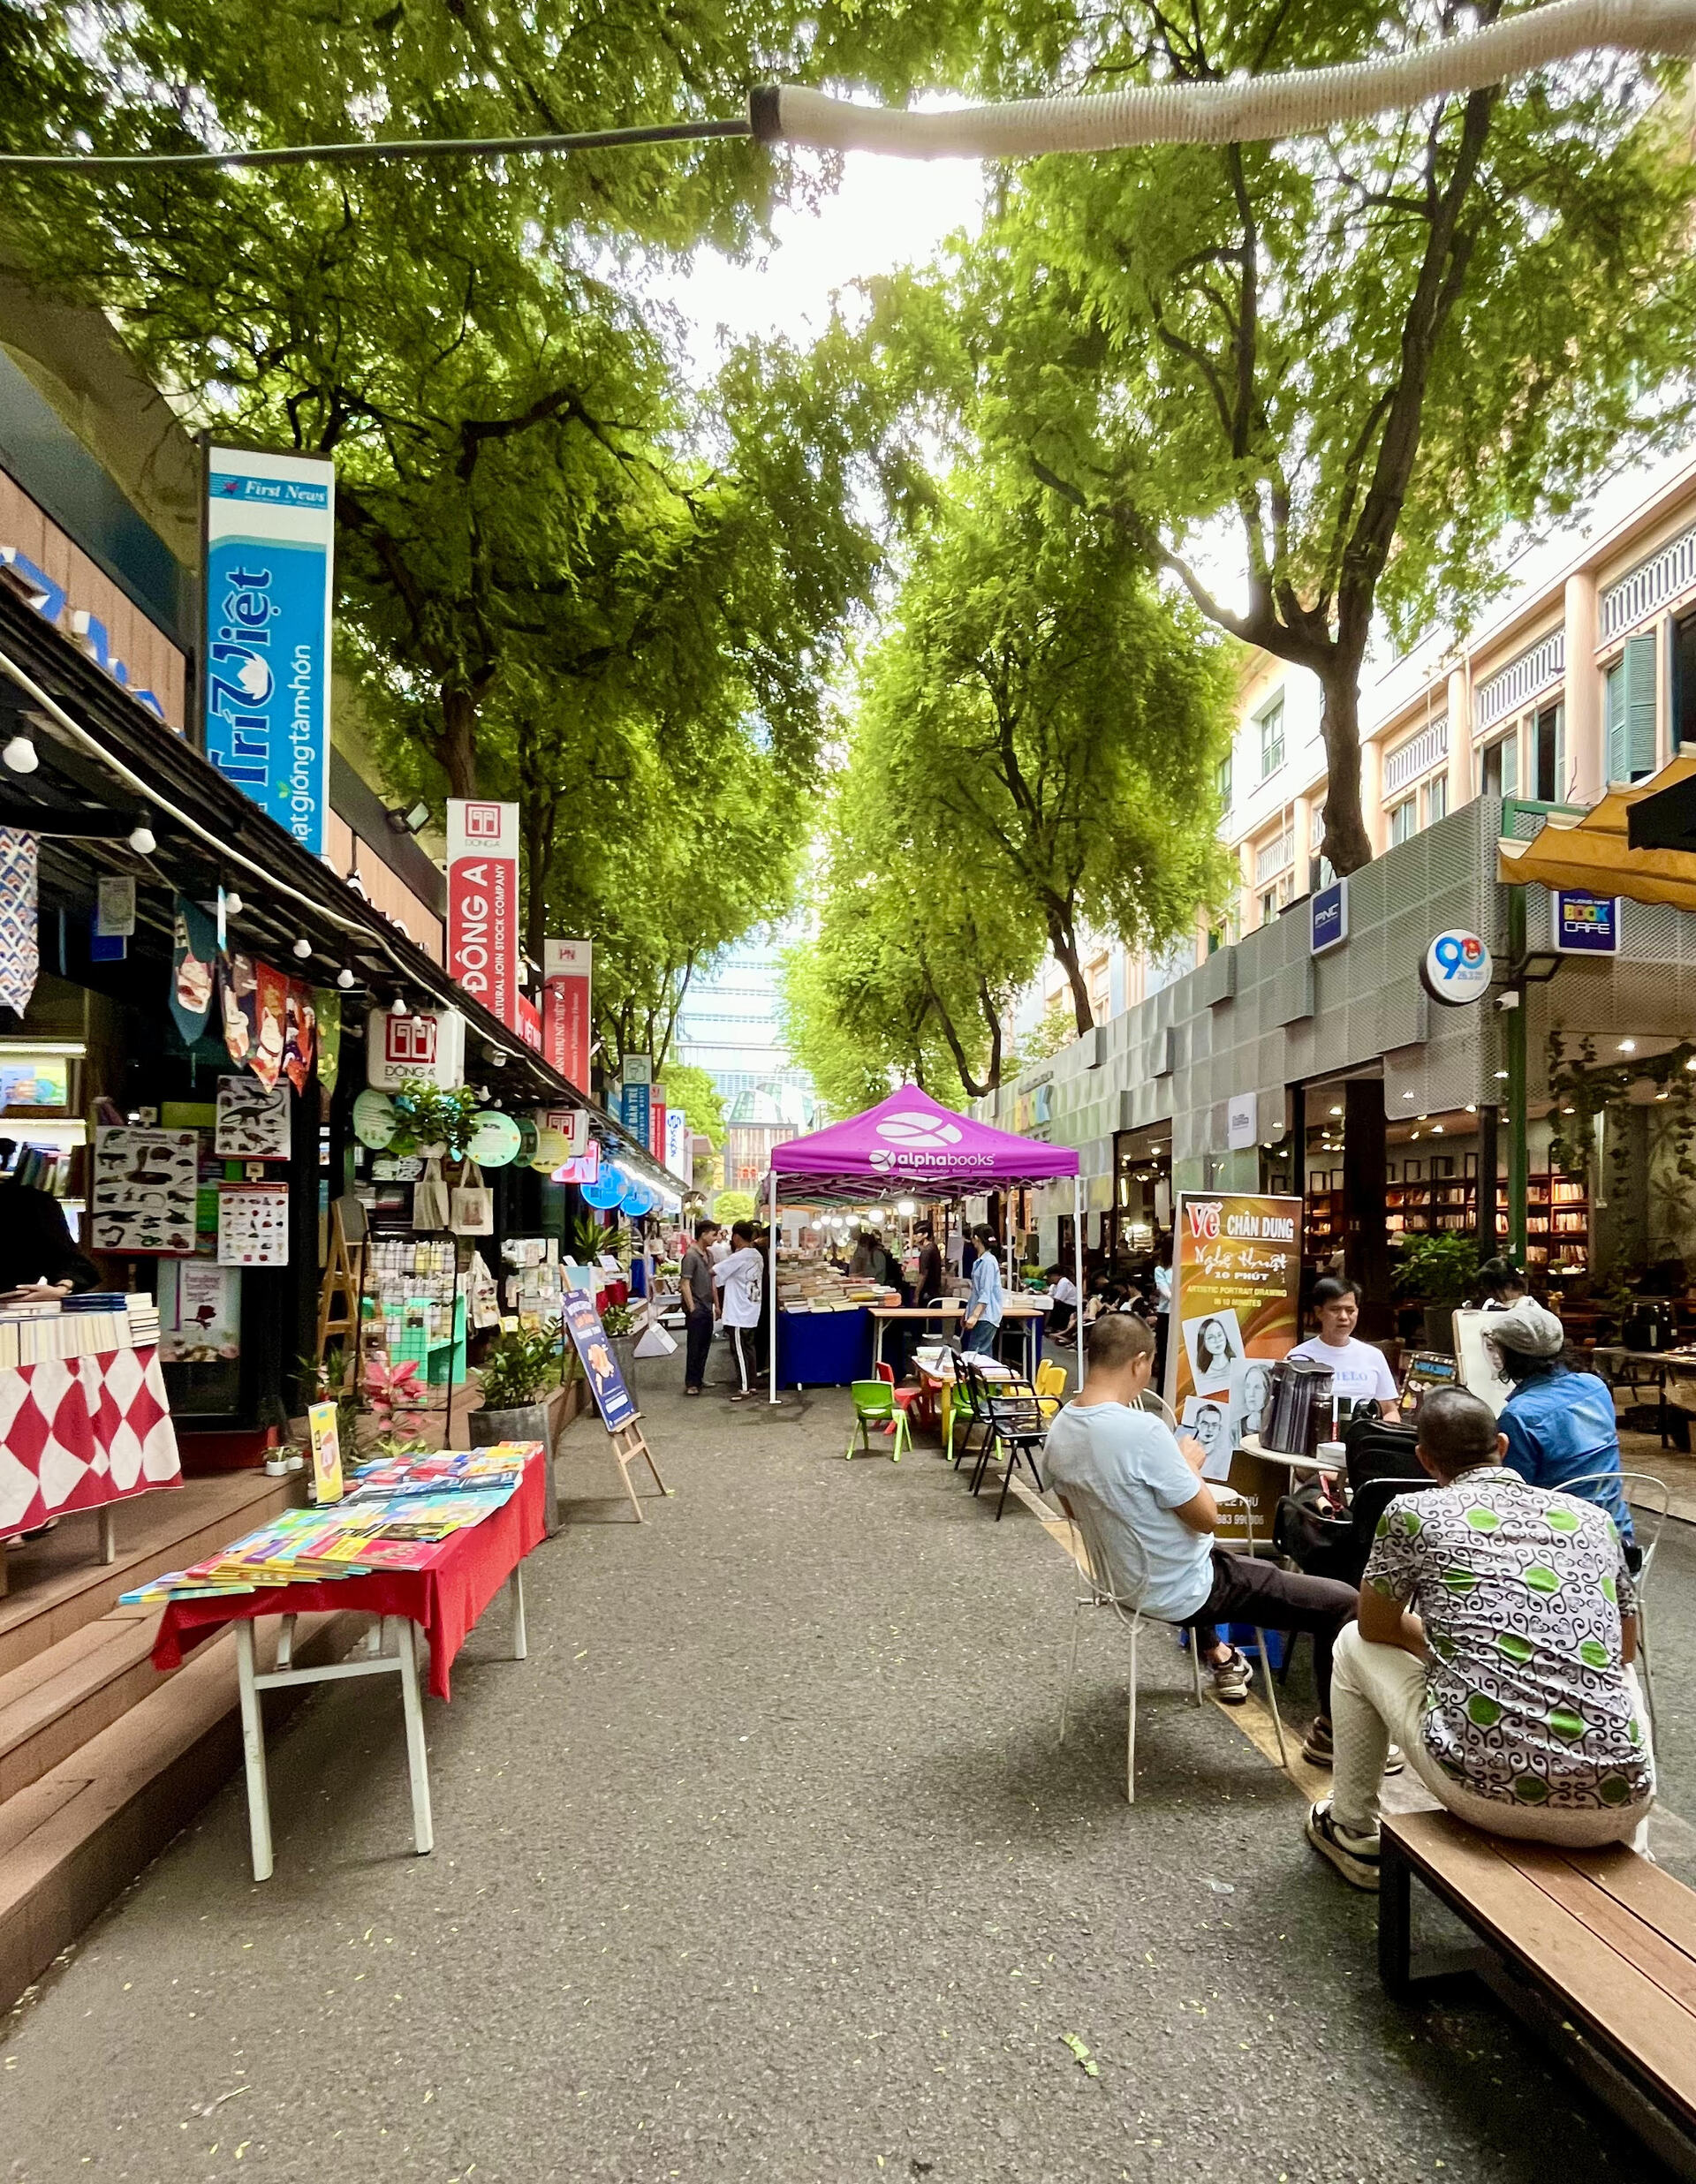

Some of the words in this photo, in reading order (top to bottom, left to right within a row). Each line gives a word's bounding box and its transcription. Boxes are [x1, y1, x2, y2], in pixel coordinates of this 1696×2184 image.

[245, 480, 281, 496] First
[284, 485, 326, 503] News
[461, 863, 488, 887] A
[494, 864, 505, 917] COMPANY
[1314, 903, 1339, 926] PNC
[1564, 903, 1609, 922] BOOK
[454, 895, 488, 994] ĐÔNG
[494, 918, 505, 950] STOCK
[494, 953, 505, 979] JOIN
[384, 1064, 425, 1078] ĐÔNG
[897, 1152, 996, 1168] alphabooks
[1185, 1201, 1223, 1239] Vẽ
[1226, 1210, 1259, 1237] CHÂN
[1261, 1216, 1294, 1239] DUNG
[1194, 1244, 1233, 1274] Nghệ
[1215, 1271, 1231, 1280] 10
[1234, 1271, 1270, 1281] PHÚT
